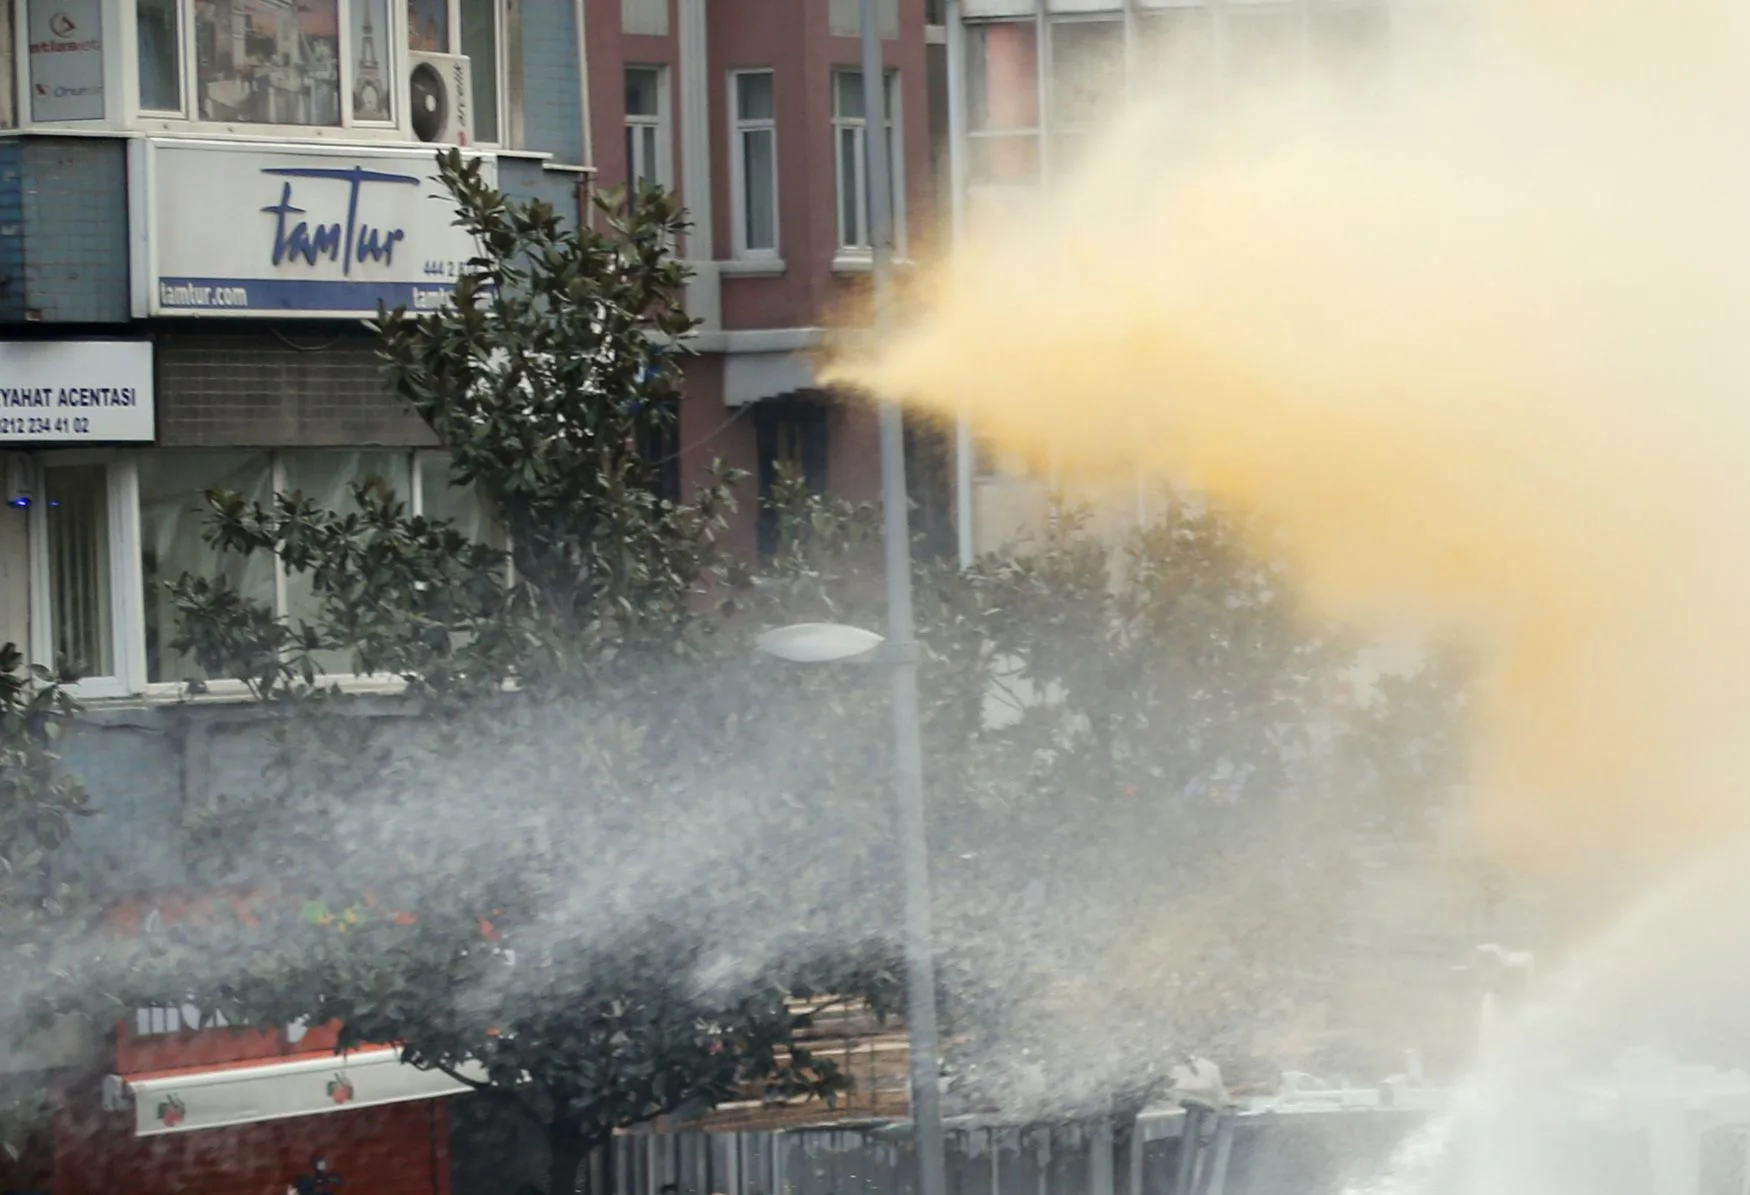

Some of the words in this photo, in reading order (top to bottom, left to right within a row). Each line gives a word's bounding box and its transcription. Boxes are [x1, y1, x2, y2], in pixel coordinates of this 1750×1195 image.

[160, 282, 248, 306] tamtur.com
[0, 388, 52, 407] YAHAT
[57, 387, 136, 407] ACENTASI
[28, 417, 51, 434] 234
[55, 417, 69, 434] 41
[73, 417, 90, 434] 02
